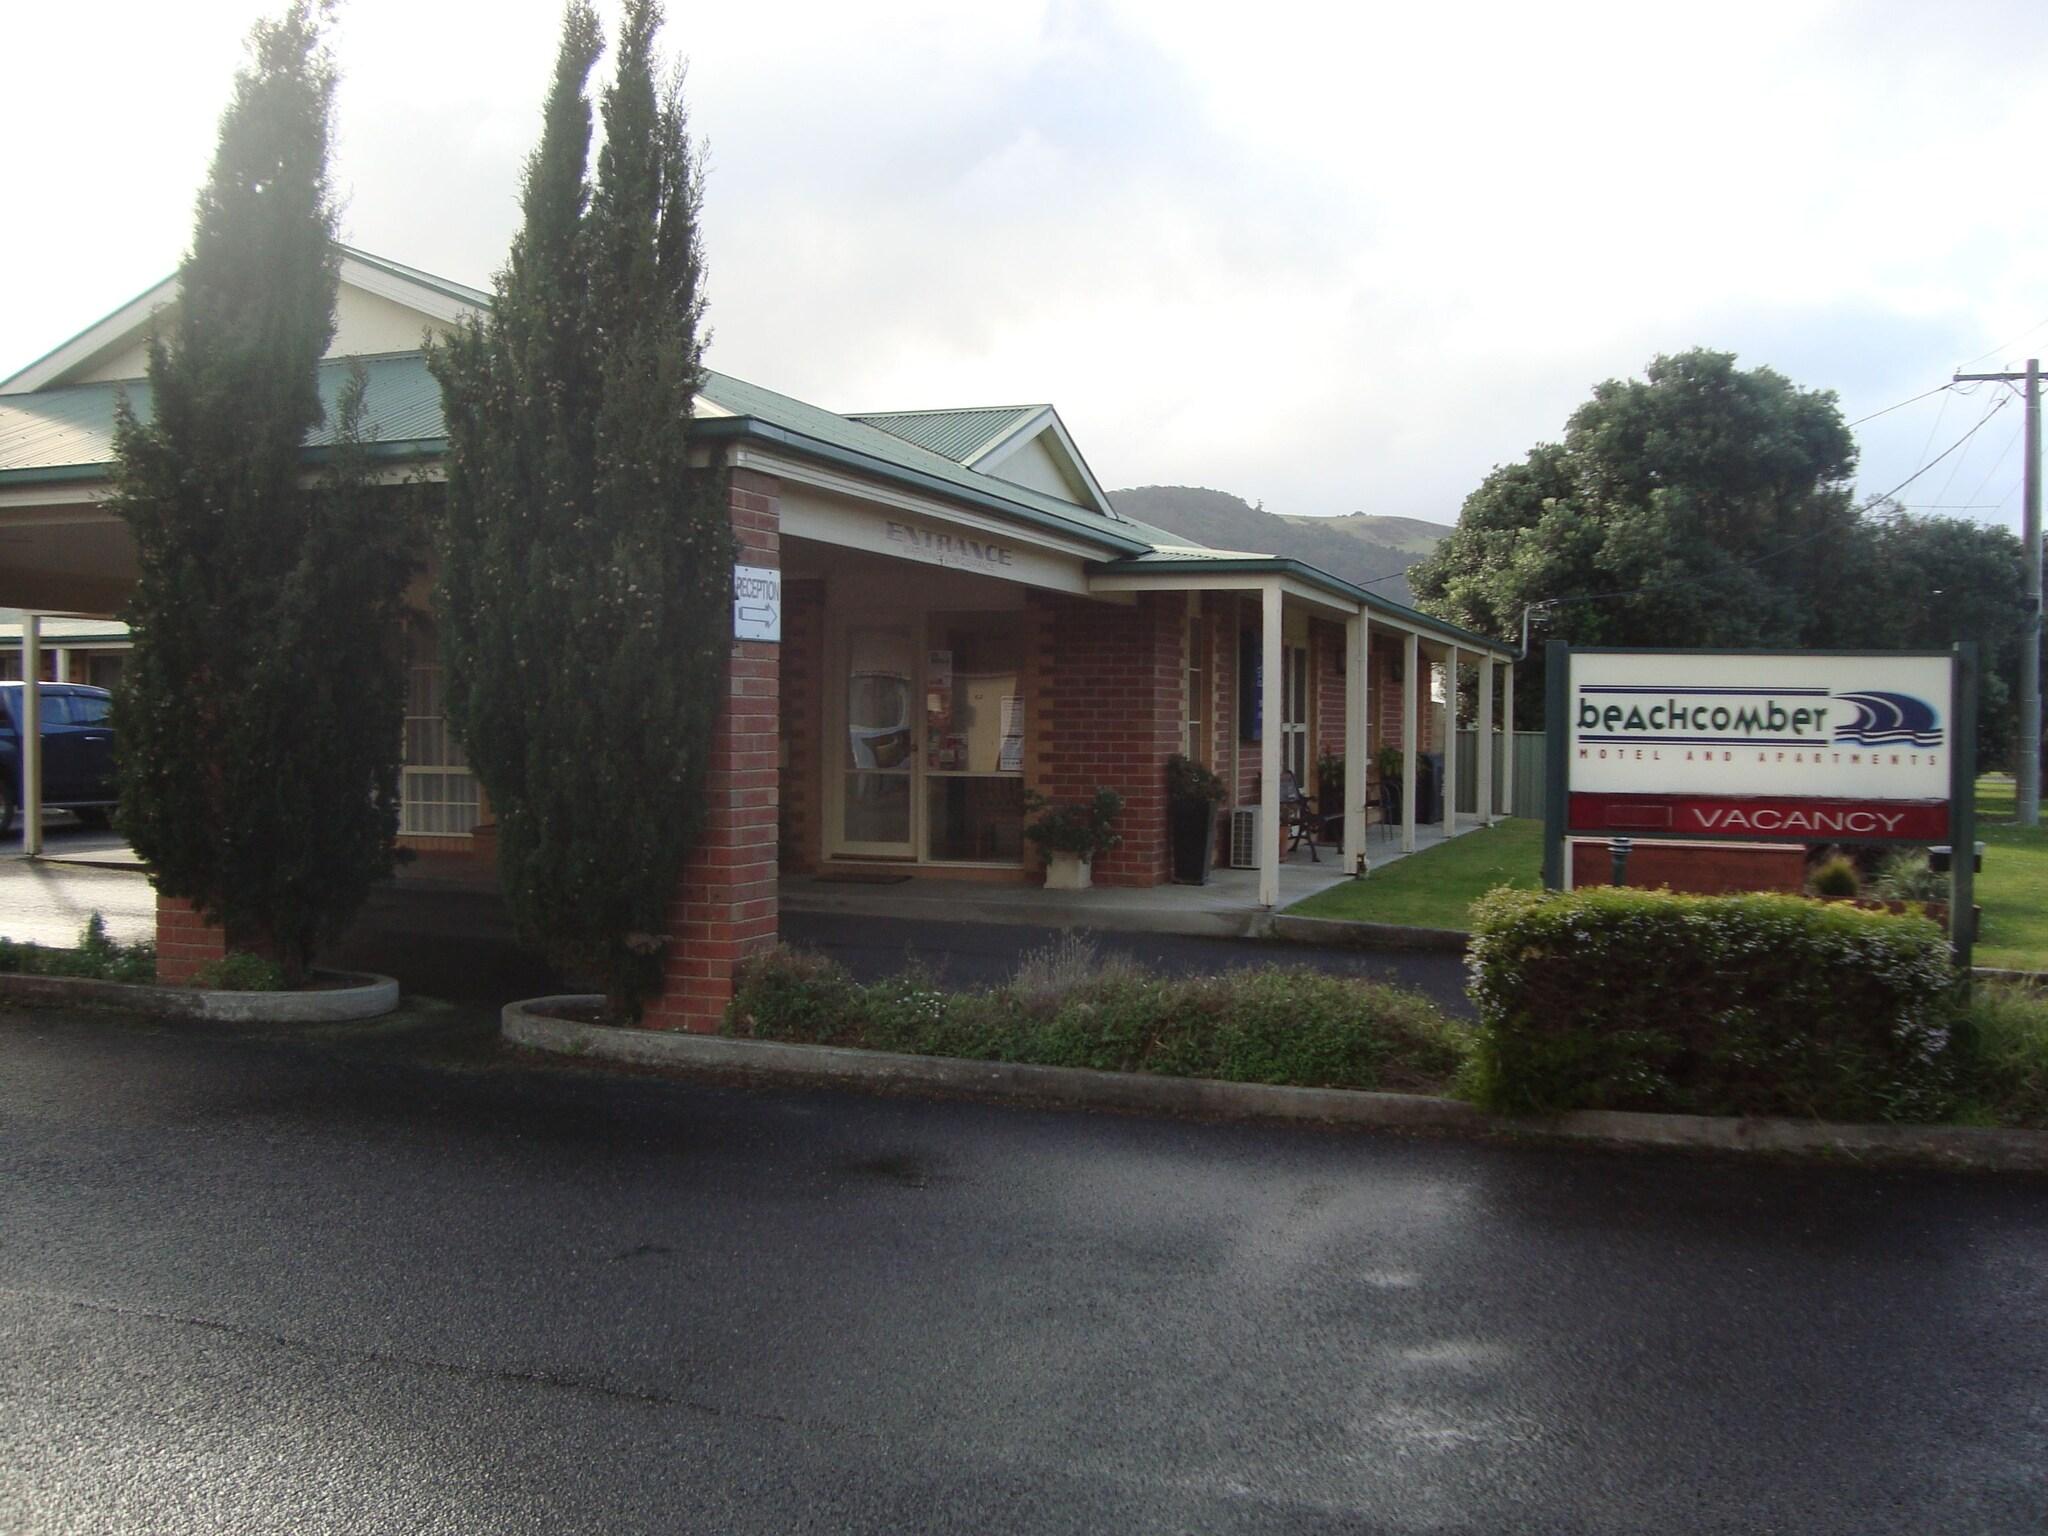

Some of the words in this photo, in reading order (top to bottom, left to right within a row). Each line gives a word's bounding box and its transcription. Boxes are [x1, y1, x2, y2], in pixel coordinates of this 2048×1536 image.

[886, 520, 1014, 567] ENTRANCE
[736, 576, 780, 601] RECEPTION
[1579, 749, 1661, 760] MOTEL
[1686, 751, 1732, 762] AND
[1757, 752, 1937, 766] APARTMENTS
[1692, 808, 1905, 832] VACANCY
